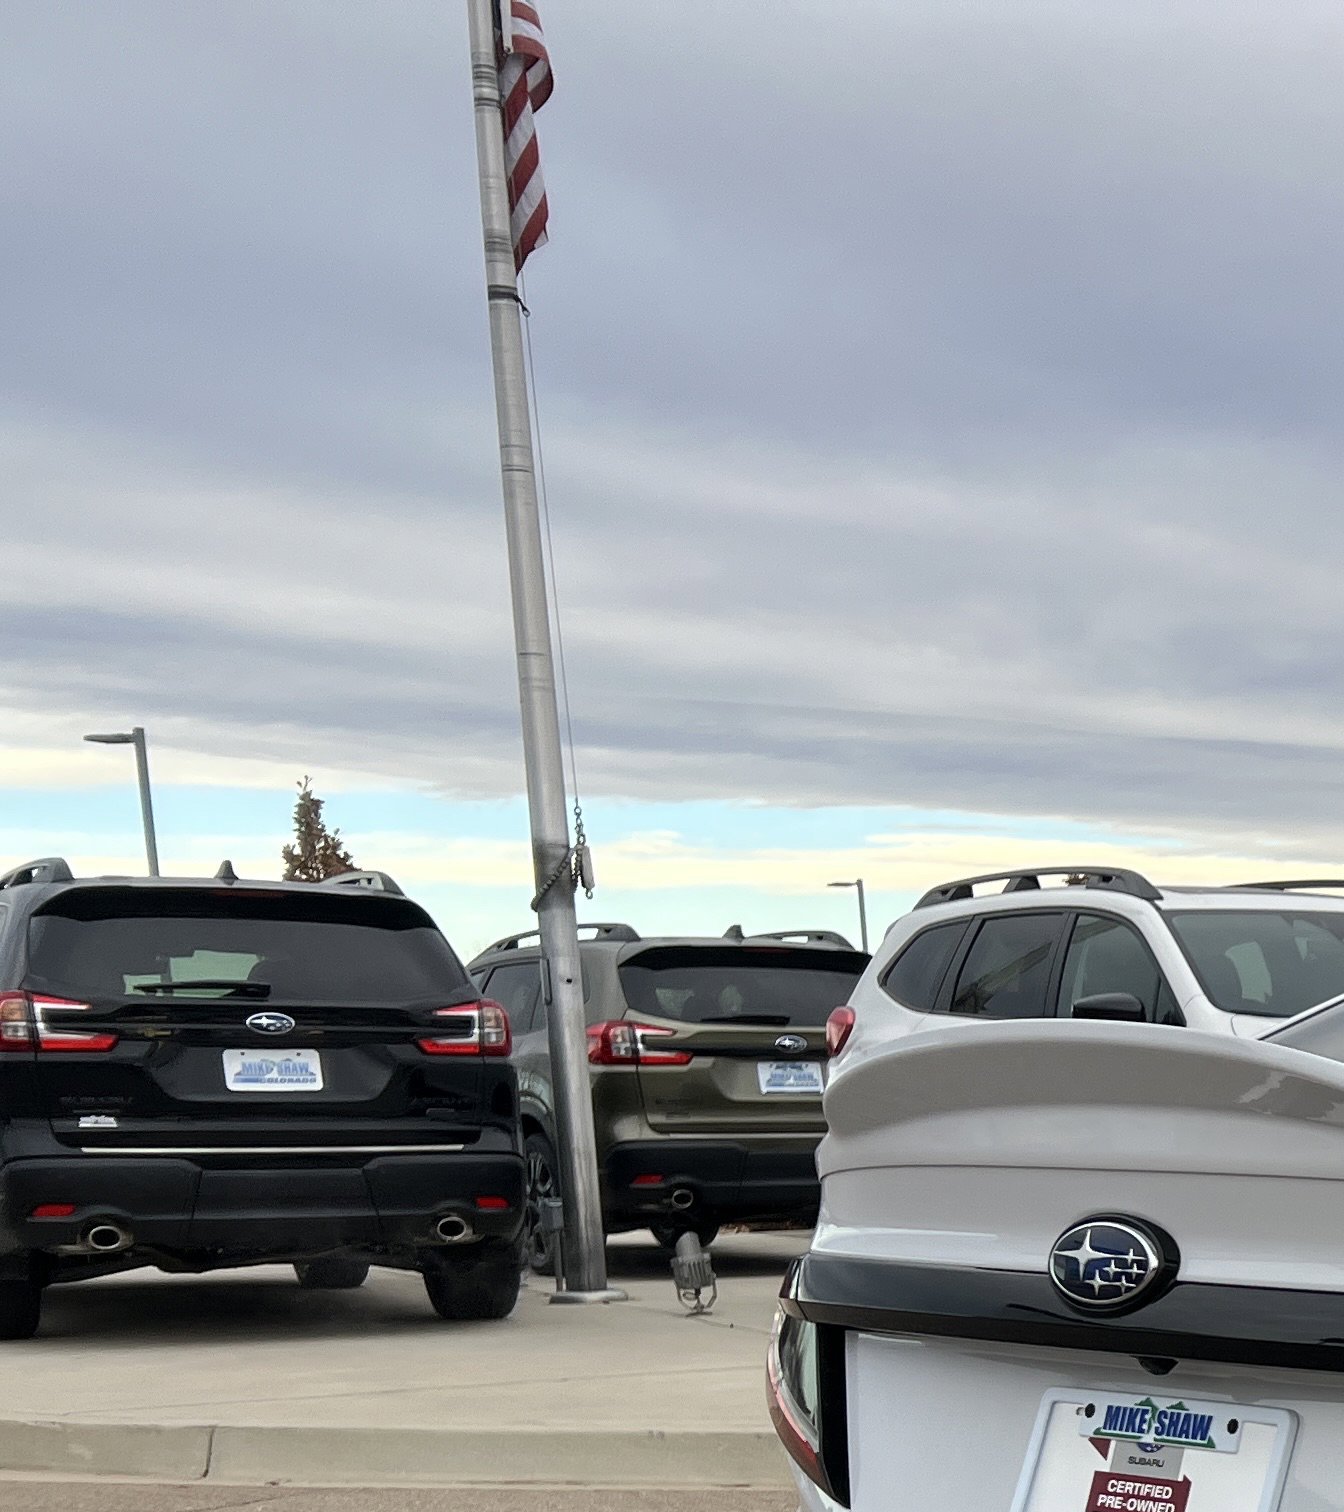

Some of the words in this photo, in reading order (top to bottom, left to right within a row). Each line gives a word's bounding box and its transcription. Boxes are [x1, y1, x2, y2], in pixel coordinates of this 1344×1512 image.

[1102, 1404, 1150, 1434] MIKE
[1154, 1409, 1213, 1441] SHAW
[1127, 1455, 1165, 1468] SUBARU
[1107, 1479, 1173, 1499] CERTIFIED
